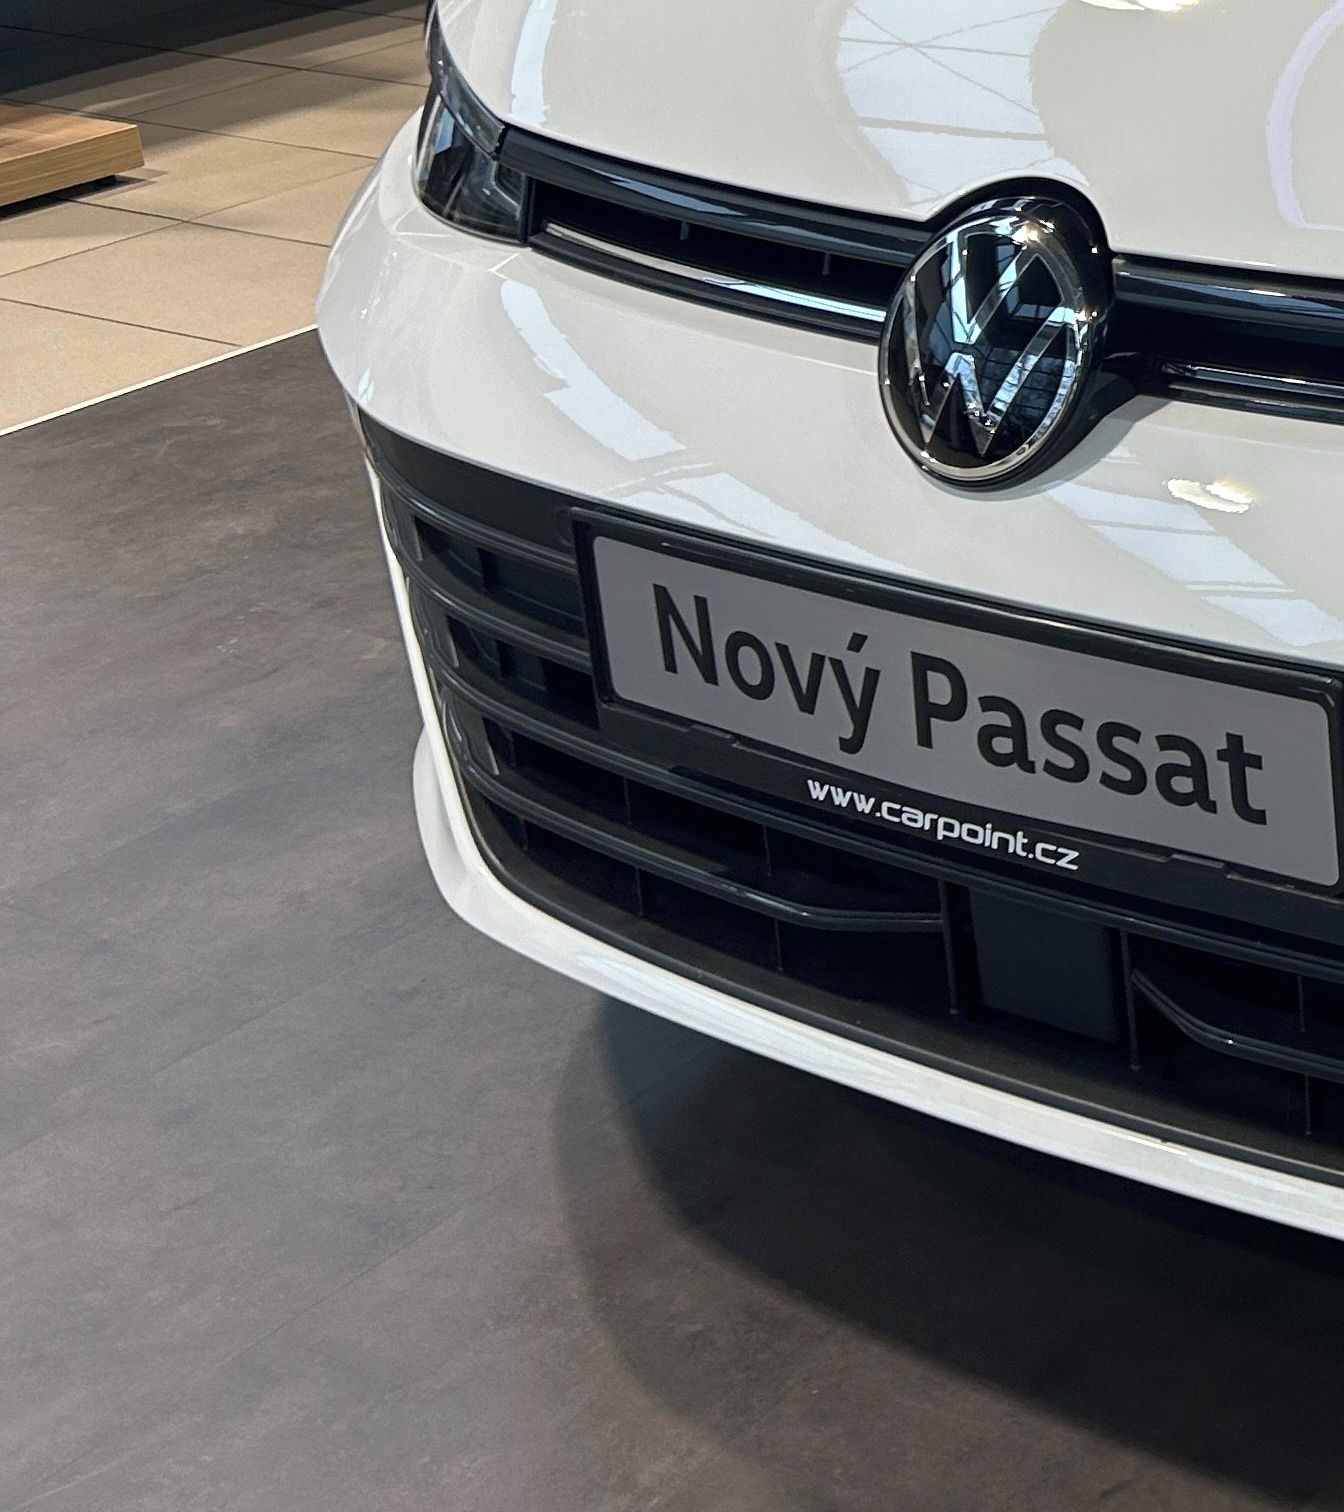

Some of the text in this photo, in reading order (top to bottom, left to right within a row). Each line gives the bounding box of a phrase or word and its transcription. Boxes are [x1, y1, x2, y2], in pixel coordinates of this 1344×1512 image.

[650, 583, 1269, 826] Nový Passat
[806, 777, 1080, 873] www.carpoint.cz
